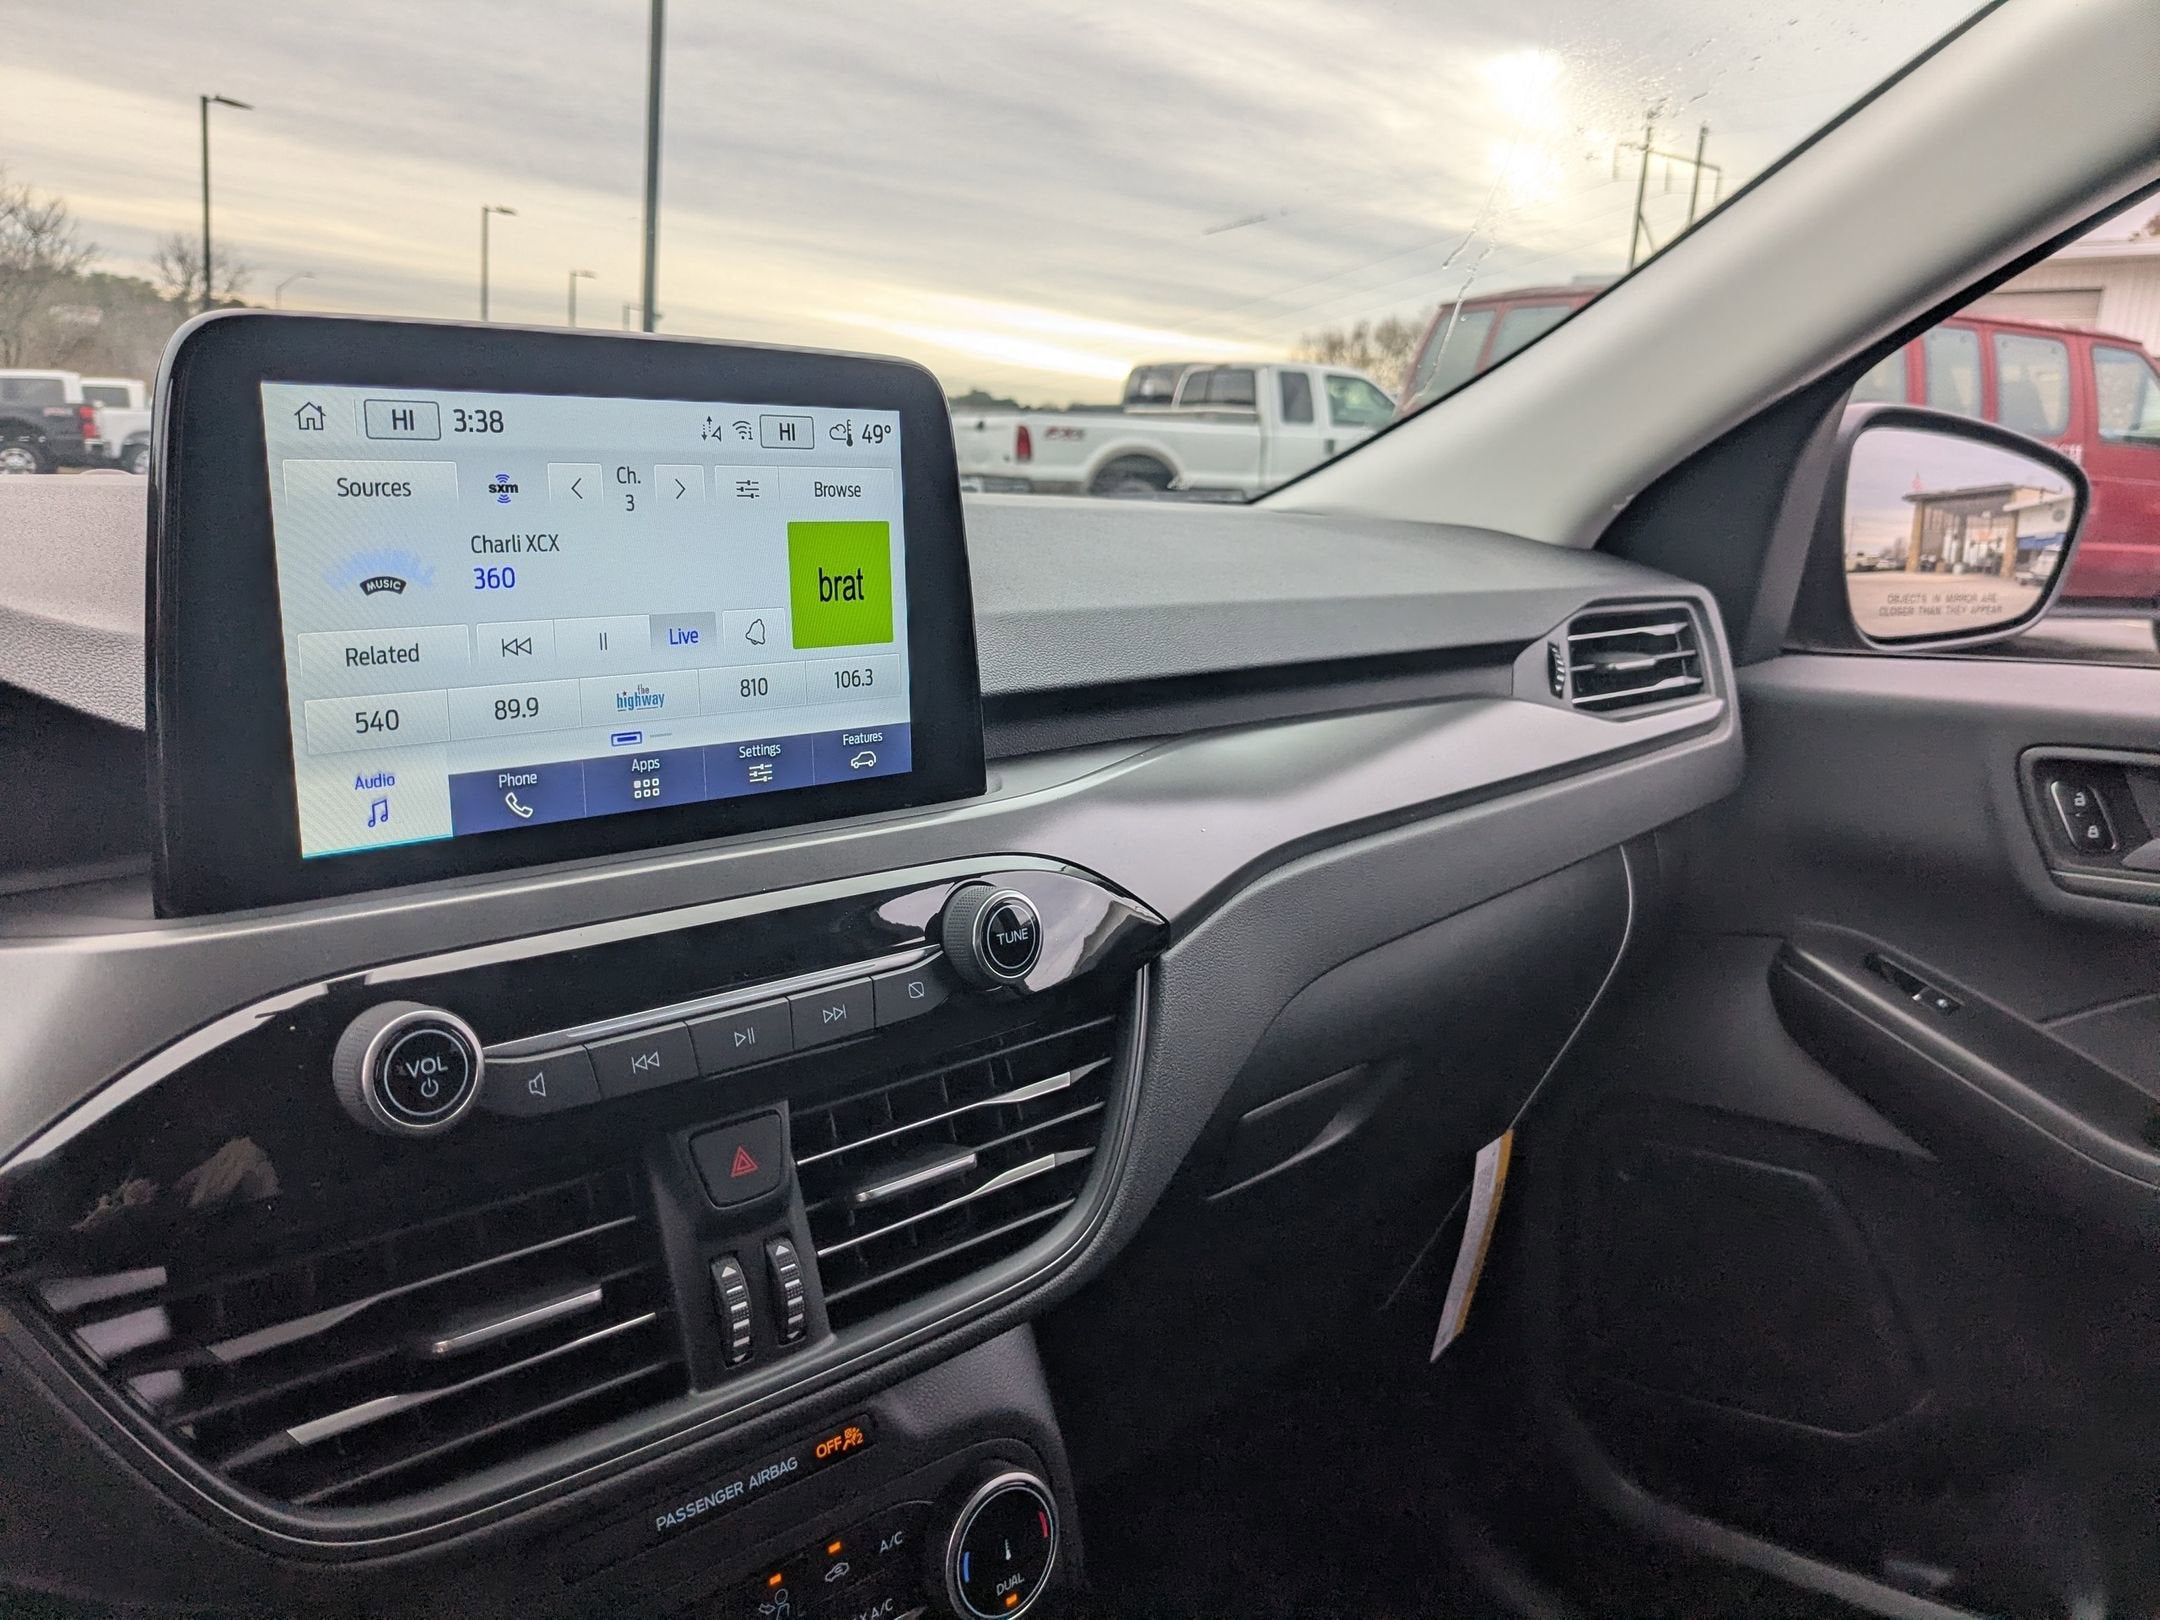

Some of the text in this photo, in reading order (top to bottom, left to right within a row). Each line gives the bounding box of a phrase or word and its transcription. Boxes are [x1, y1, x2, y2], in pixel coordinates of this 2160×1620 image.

[391, 408, 415, 431] HI
[453, 408, 505, 433] 3:38
[778, 422, 797, 442] HI
[616, 466, 642, 485] Ch.
[336, 477, 412, 498] Sources
[488, 482, 519, 494] sxm
[814, 481, 862, 498] Browse
[625, 495, 635, 512] 3
[470, 534, 560, 554] Charli XCX
[366, 579, 402, 592] MUSIC
[473, 566, 516, 590] 360
[818, 567, 865, 602] brat
[669, 628, 699, 646] Live
[345, 643, 420, 667] Related
[637, 683, 650, 695] the
[740, 677, 768, 698] 810
[834, 669, 873, 689] 106.3
[494, 697, 539, 721] 89.9
[616, 691, 665, 711] highway
[355, 709, 399, 734] 540
[842, 732, 883, 747] Features
[739, 744, 781, 759] Settings
[631, 758, 661, 773] Apps
[354, 773, 395, 791] Audio
[498, 772, 537, 788] Phone
[996, 928, 1029, 945] TUNE
[405, 1056, 449, 1079] VOL
[815, 1436, 841, 1458] OFF
[656, 1456, 799, 1532] PASSENGER AIRBAG
[879, 1530, 904, 1554] A/C
[996, 1572, 1025, 1596] DUAL
[870, 1598, 894, 1620] A/C
